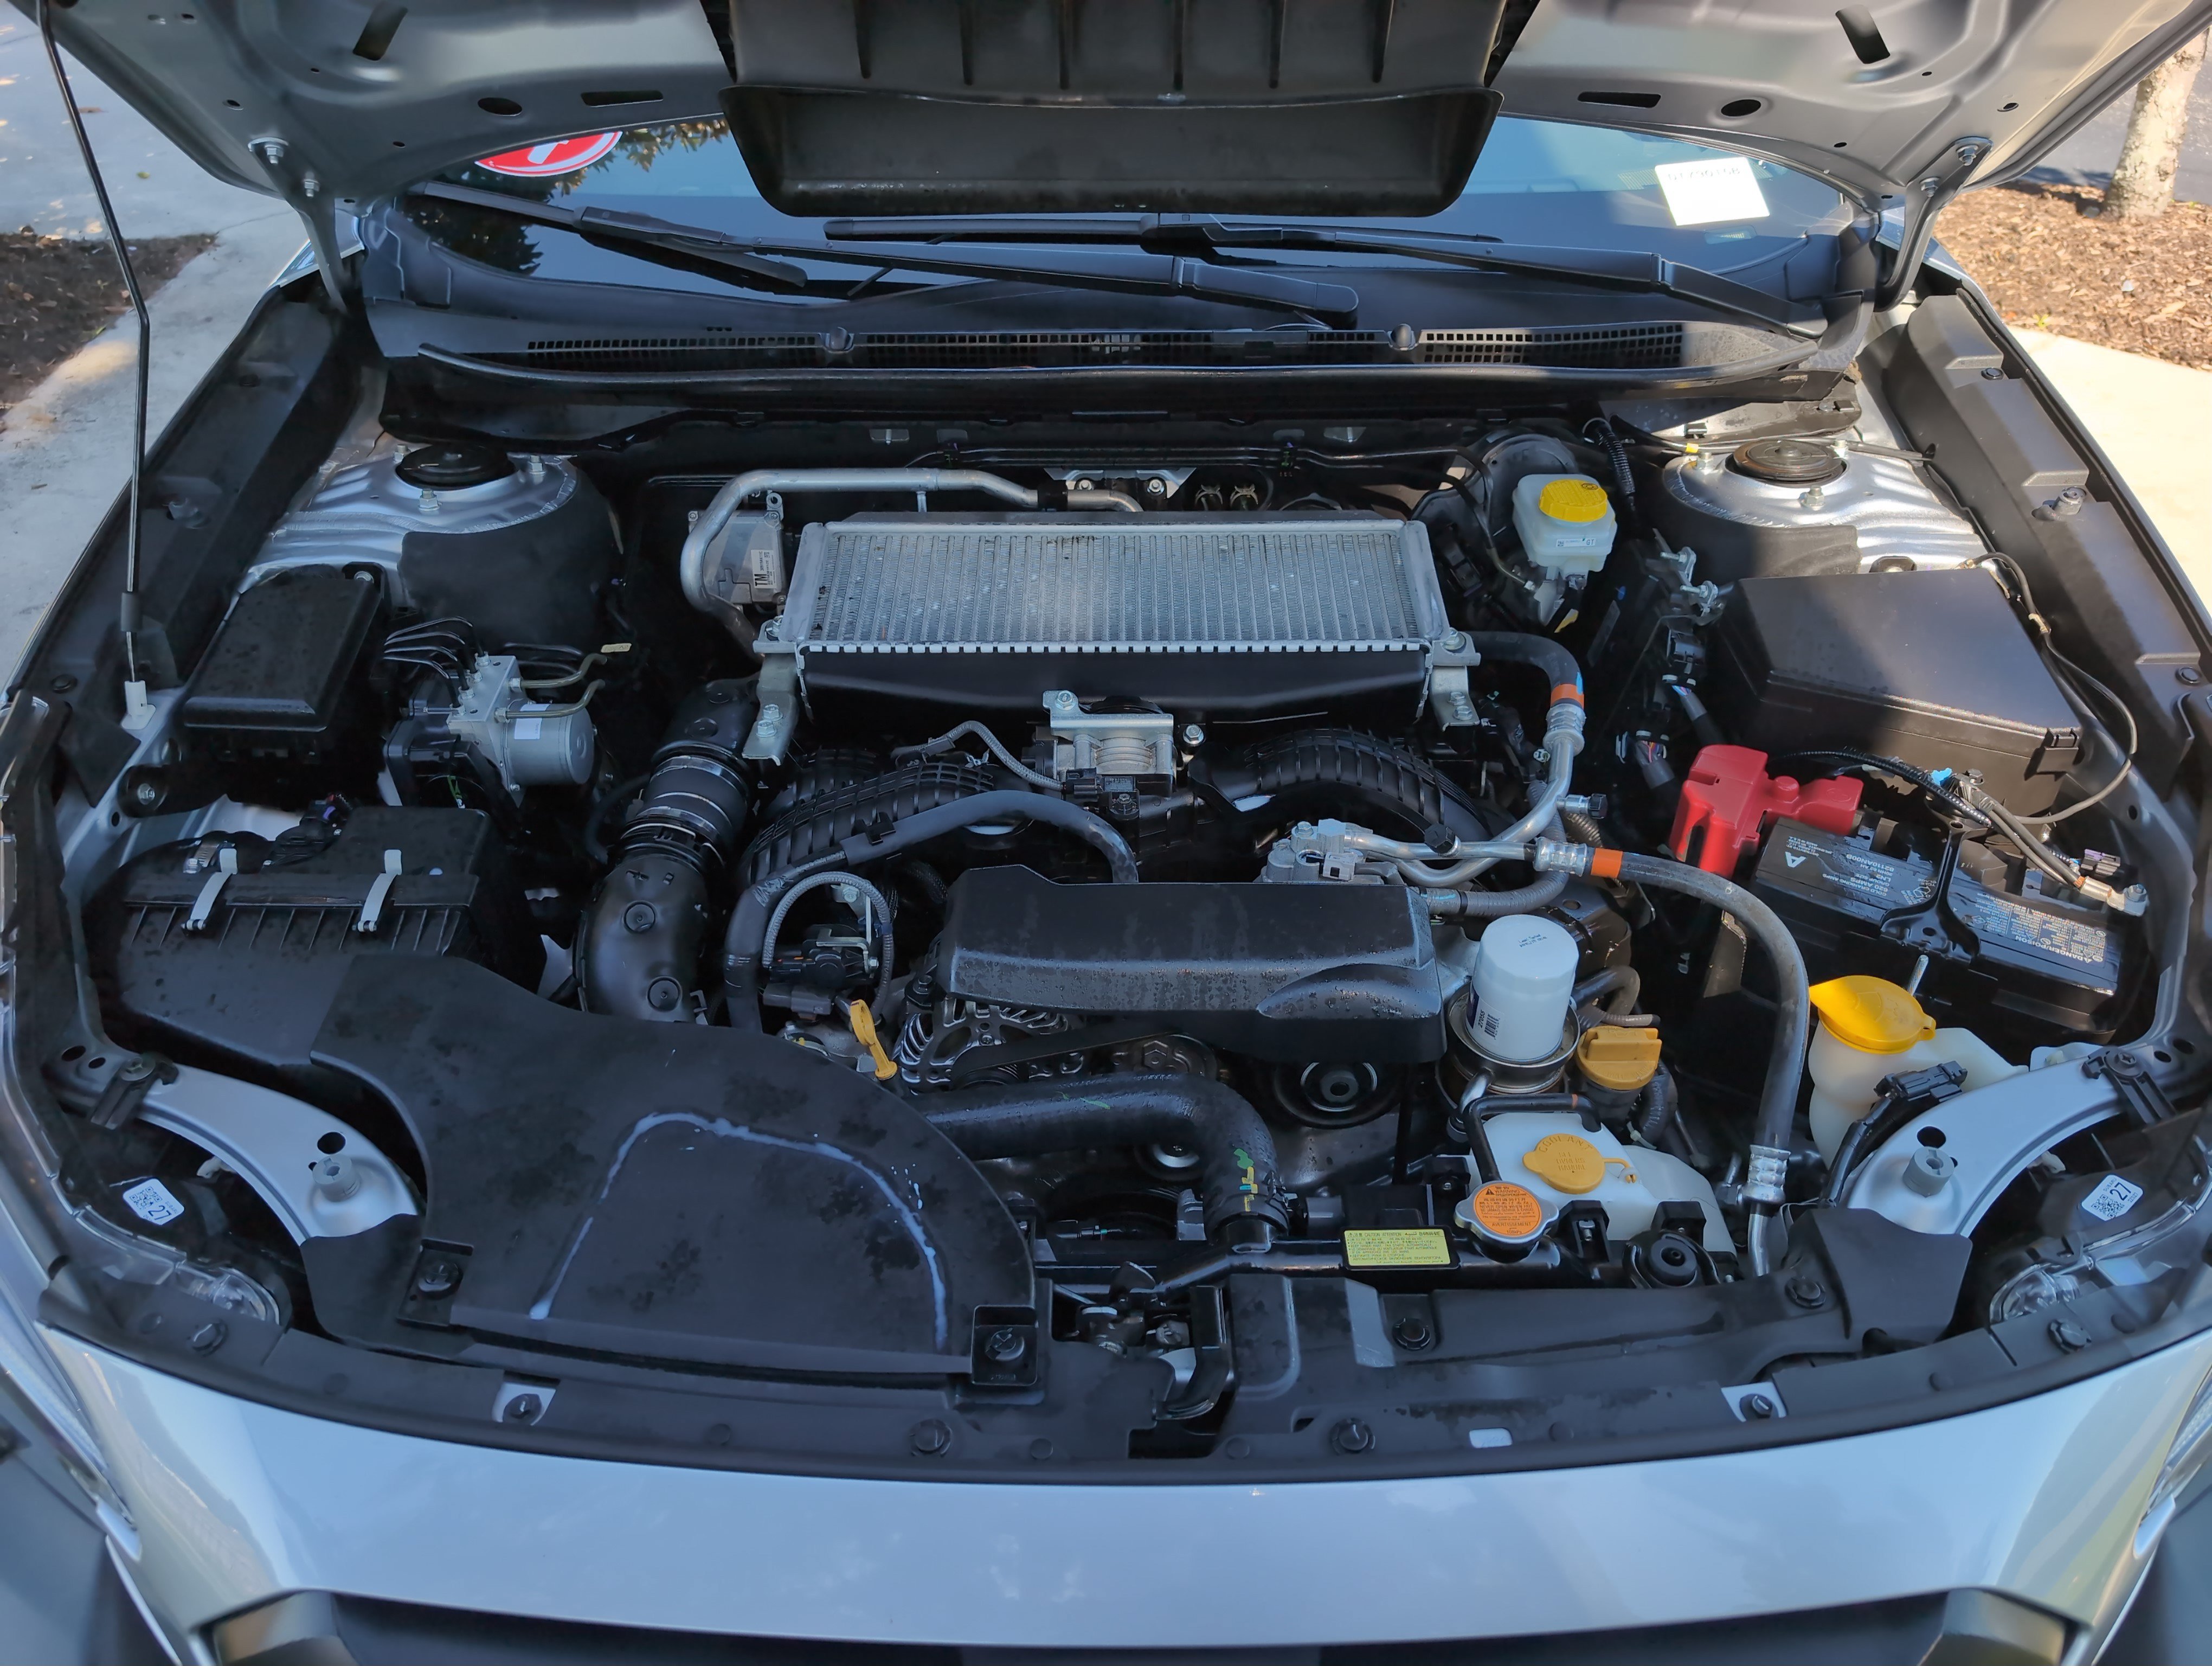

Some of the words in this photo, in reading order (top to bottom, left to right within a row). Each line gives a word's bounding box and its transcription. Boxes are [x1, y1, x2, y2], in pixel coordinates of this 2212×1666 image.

[754, 573, 768, 587] TM
[1785, 851, 1806, 868] A
[1846, 854, 1895, 872] 82110AN00B
[1840, 879, 1870, 891] CRANKING
[1850, 877, 1874, 887] AMPS
[1869, 878, 1890, 887] GROUP
[2014, 935, 2086, 962] DANGER/POISON
[1539, 1135, 1593, 1154] COOLANT
[2110, 1182, 2132, 1201] 27
[148, 1205, 172, 1221] 27
